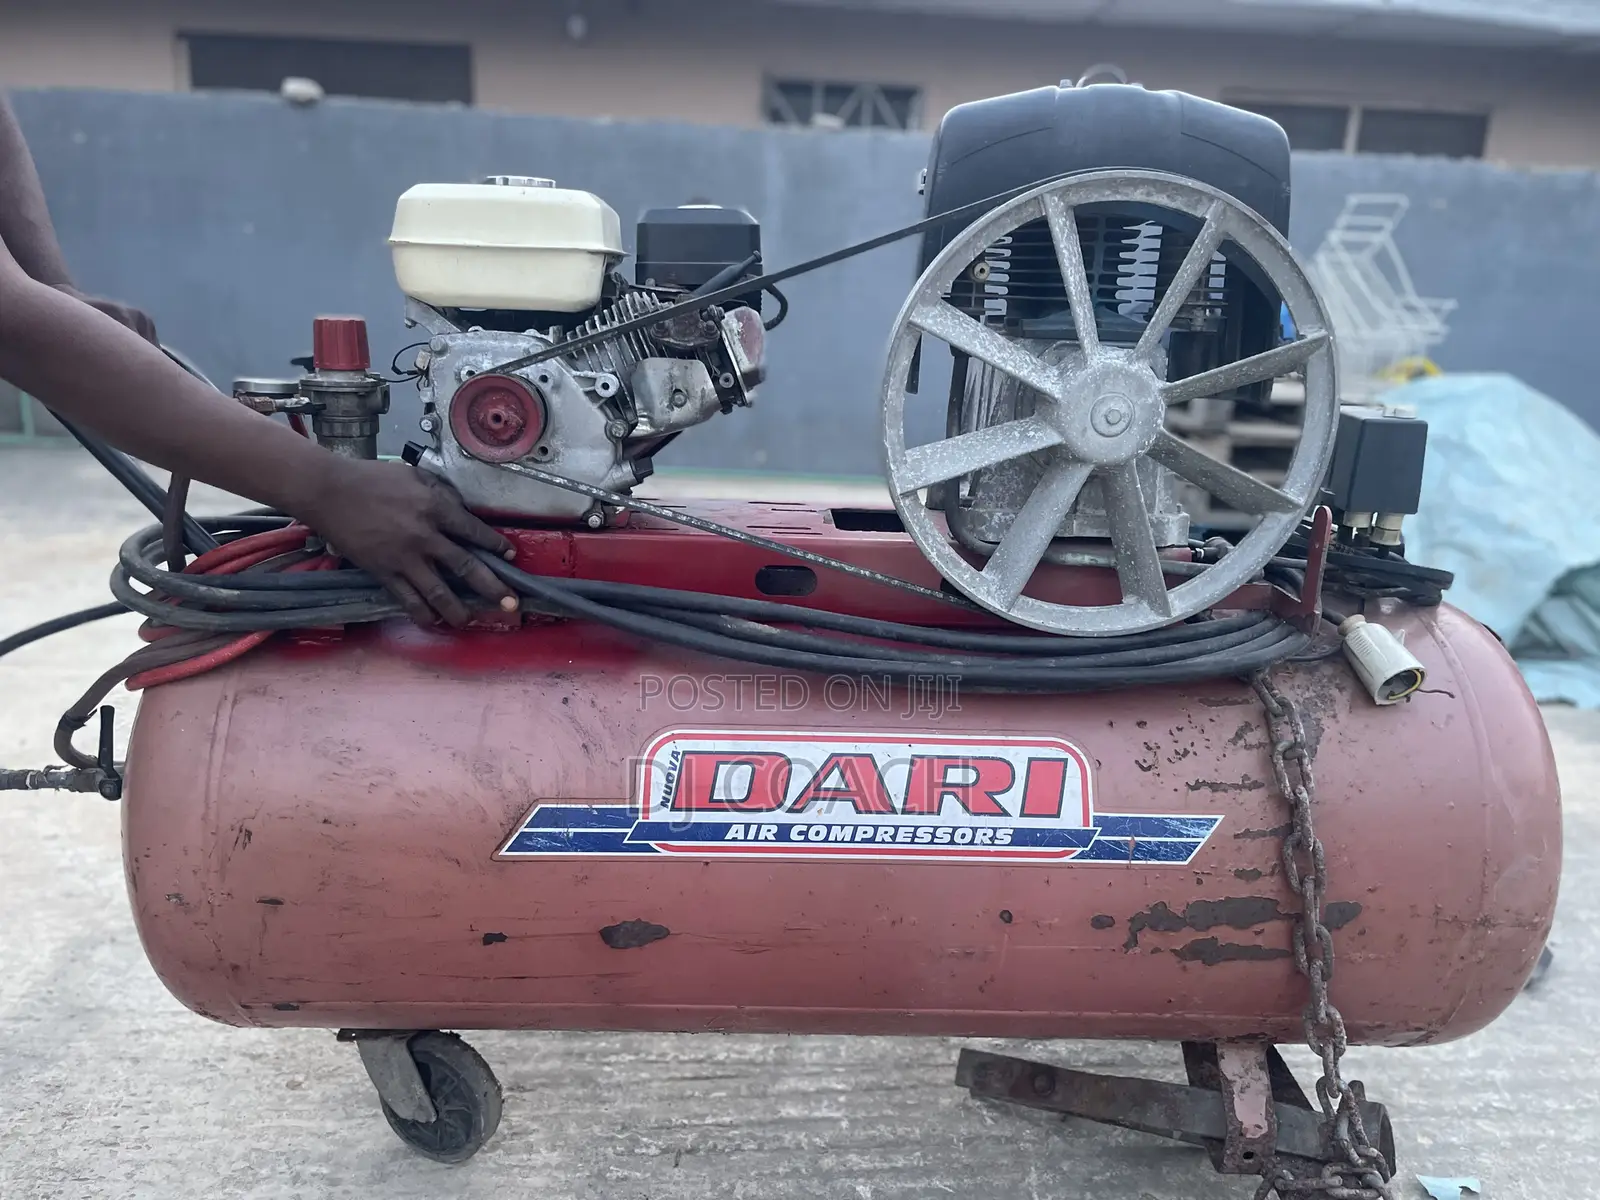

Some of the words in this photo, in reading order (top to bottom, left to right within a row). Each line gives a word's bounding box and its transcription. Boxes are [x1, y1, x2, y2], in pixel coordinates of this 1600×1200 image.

[660, 750, 681, 809] NUOVA
[670, 750, 1068, 819] DARI
[724, 824, 778, 841] AIR
[789, 824, 1014, 845] COMPRESSORS
